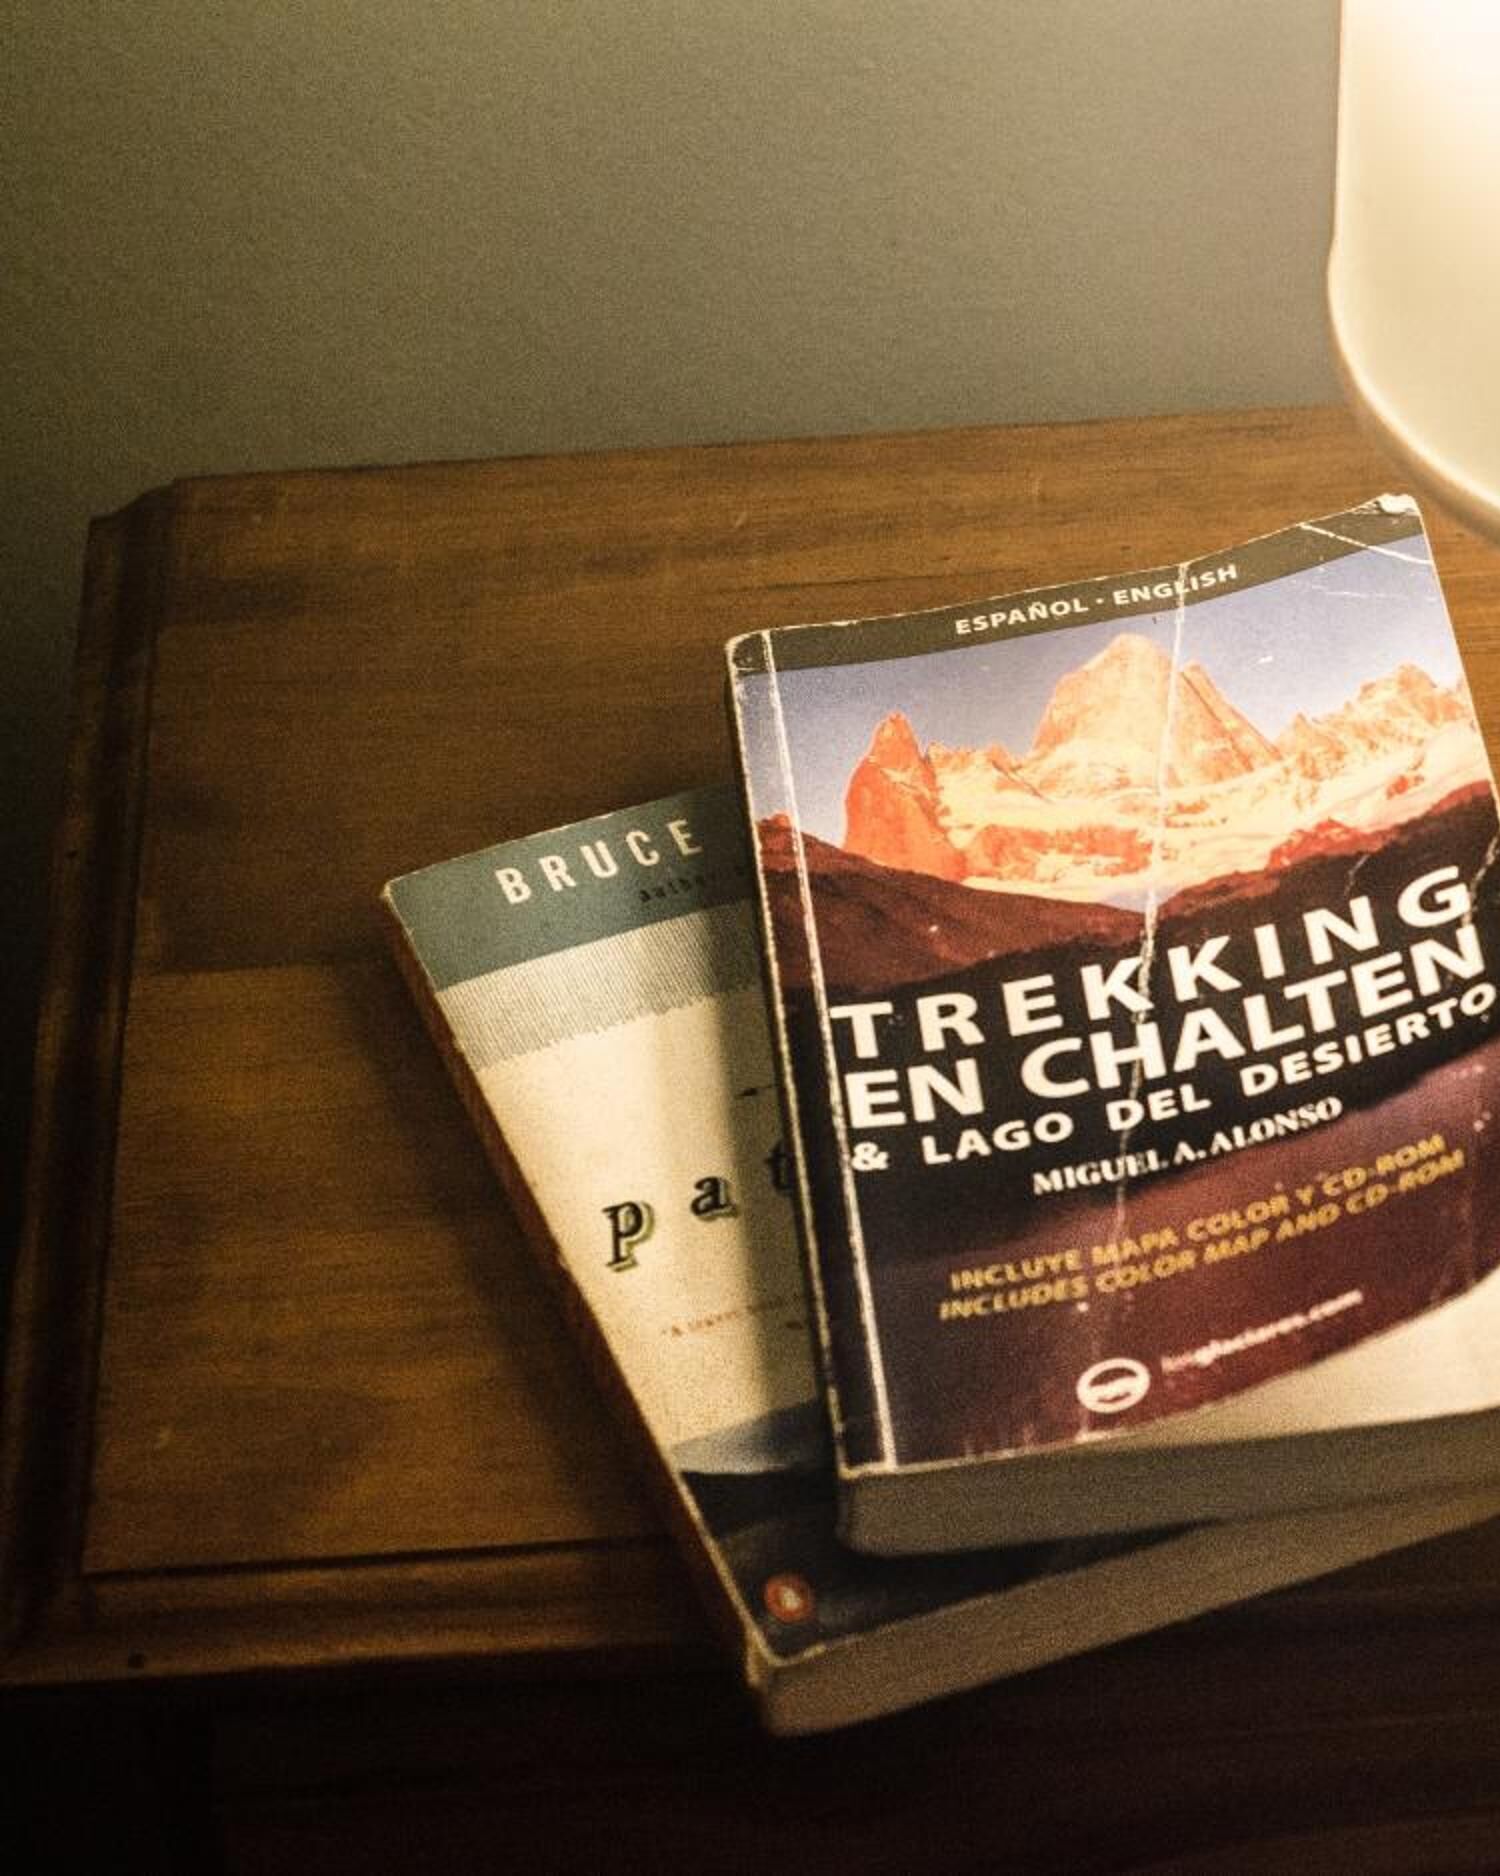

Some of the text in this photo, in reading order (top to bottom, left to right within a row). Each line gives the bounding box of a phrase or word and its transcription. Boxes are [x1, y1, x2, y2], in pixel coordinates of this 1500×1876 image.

[955, 564, 1238, 635] ESPAÑOL ENGLISH
[495, 818, 703, 905] BRUCE
[830, 866, 1471, 1059] TREKKING
[845, 923, 1485, 1129] EN CHALTEN
[851, 982, 1496, 1171] & LAGO DEL DESIERTO
[1033, 1149, 1167, 1195] MIGUEL
[1210, 1096, 1343, 1155] ALONSO
[939, 1149, 1465, 1321] INCLUDES COLOR MAP AND CD-ROM
[951, 1133, 1446, 1291] INCLUYE MAPA COLOR Y CD-ROM
